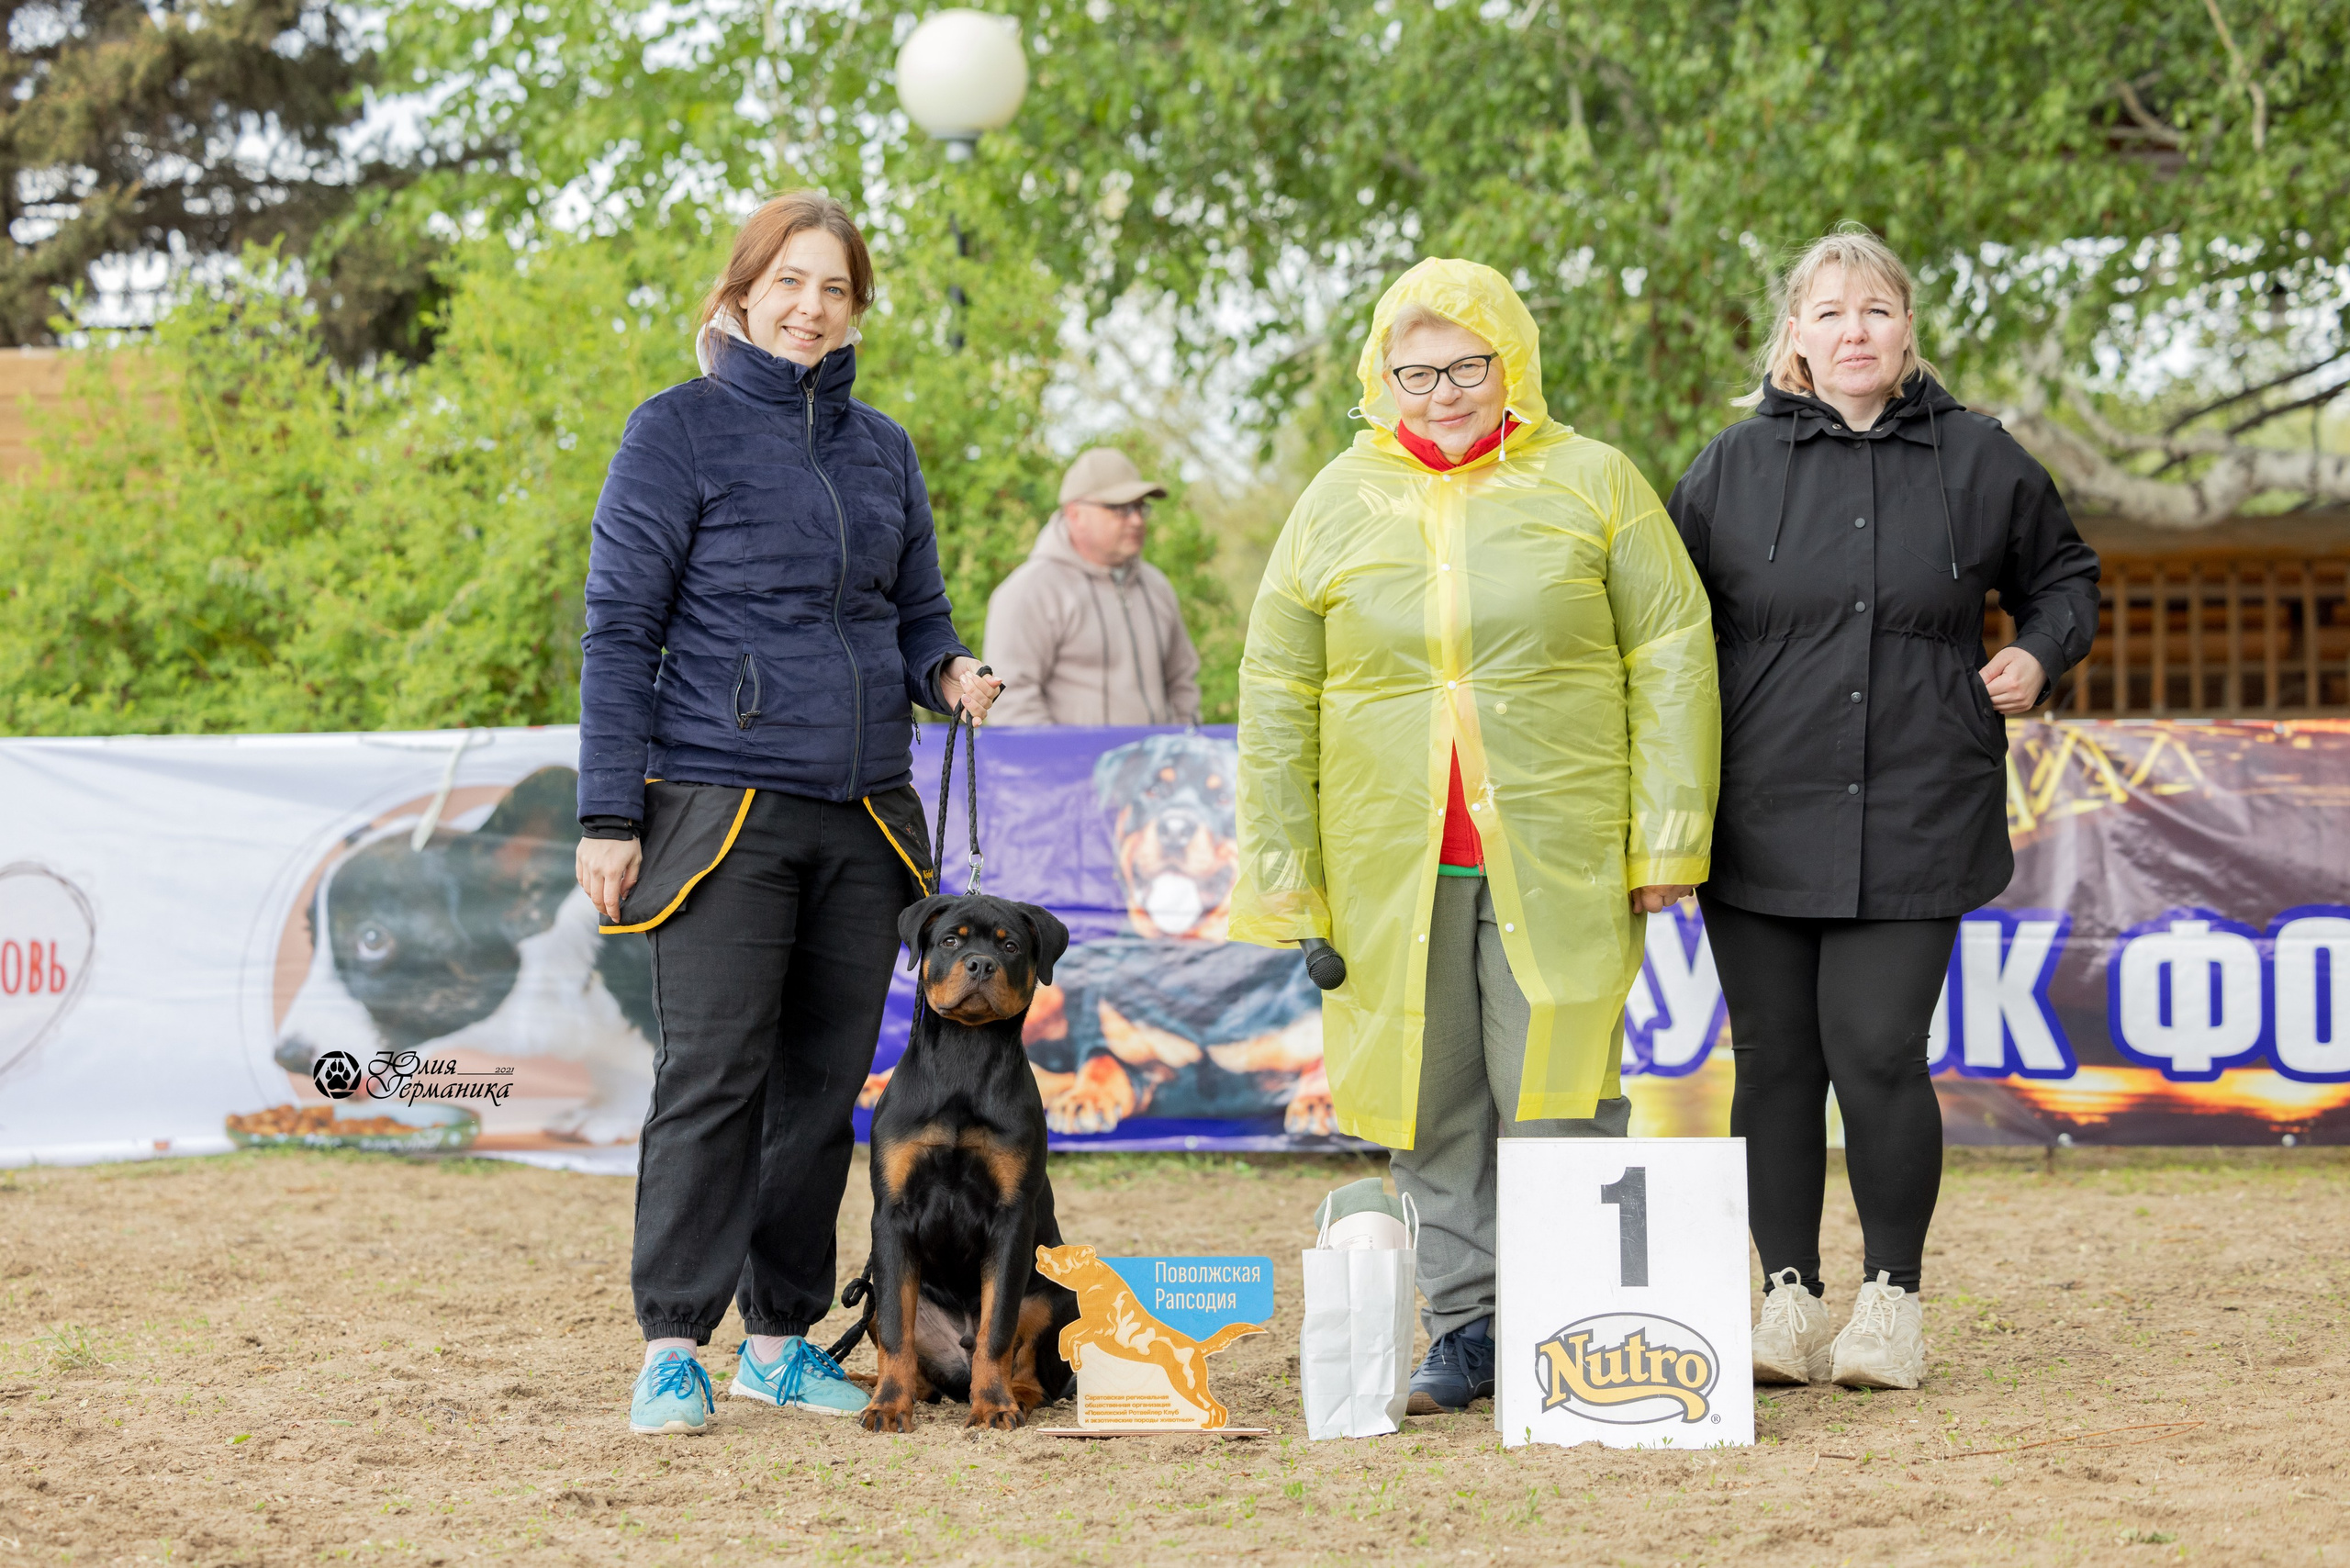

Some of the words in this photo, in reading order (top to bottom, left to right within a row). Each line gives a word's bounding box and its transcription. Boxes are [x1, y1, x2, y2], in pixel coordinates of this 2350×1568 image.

[1600, 1166, 1650, 1287] 1
[1155, 1260, 1261, 1283] Поволжская
[1155, 1287, 1237, 1314] Рапсодия
[1536, 1327, 1712, 1422] Nutro
